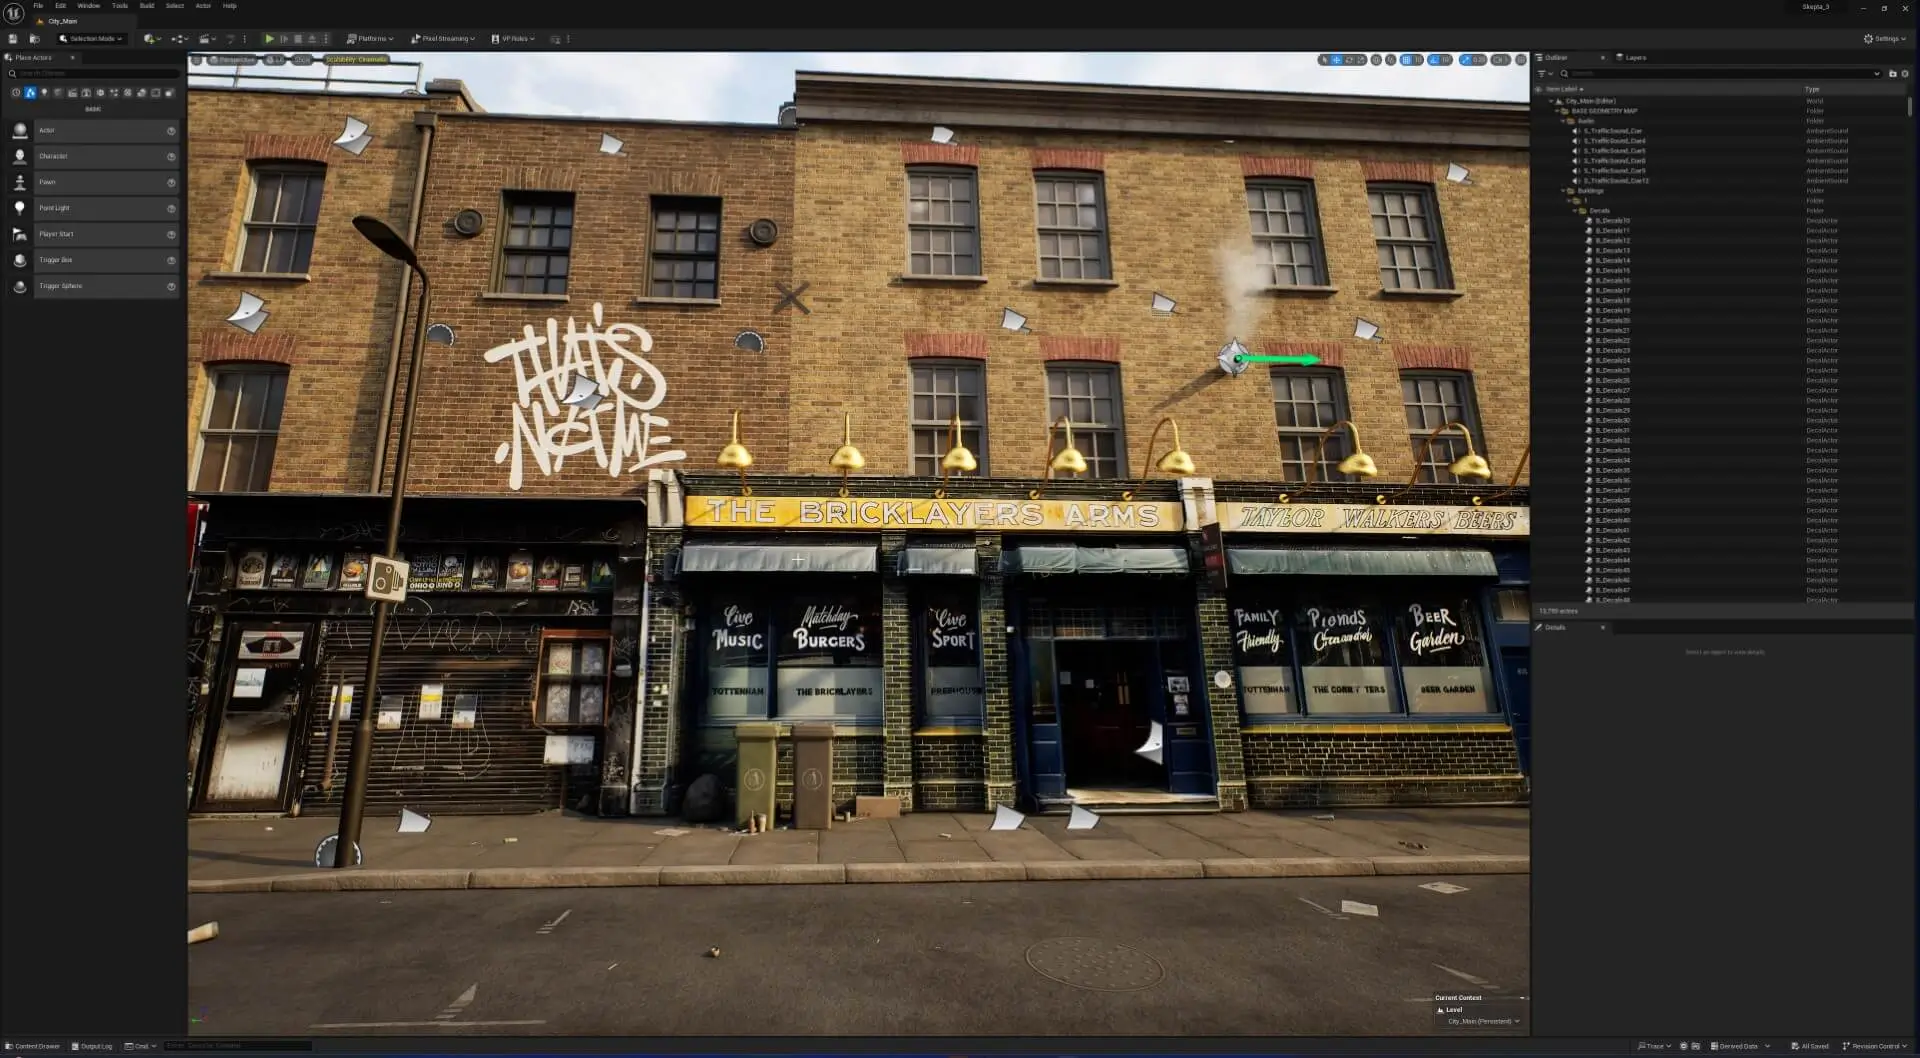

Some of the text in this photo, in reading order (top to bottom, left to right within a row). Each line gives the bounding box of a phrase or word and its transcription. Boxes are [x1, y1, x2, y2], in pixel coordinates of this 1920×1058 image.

[48, 18, 77, 26] City_Main
[358, 36, 386, 44] Platforms
[1875, 36, 1899, 44] Settings
[16, 53, 31, 61] Place
[40, 283, 61, 291] Trigger
[708, 499, 1160, 528] THE BRICKLAYERS ARMS
[1242, 506, 1518, 531] TAYLOR WALKERS BEERS
[724, 605, 753, 627] Live
[801, 605, 858, 631] Matchday
[935, 607, 967, 628] Live
[1234, 608, 1279, 627] FAMILY
[1409, 603, 1457, 627] BEER
[712, 629, 764, 651] MUSIC
[793, 627, 865, 651] BURGERS
[932, 629, 976, 650] SPORT
[1236, 629, 1284, 653] Friendly
[1410, 629, 1466, 656] Garden
[712, 687, 764, 696] TOTTENHAM
[796, 687, 873, 696] THE BRICKLAYERS
[1312, 685, 1330, 694] THE
[1421, 685, 1476, 694] BEER GARDEN
[81, 1042, 112, 1052] Output Log
